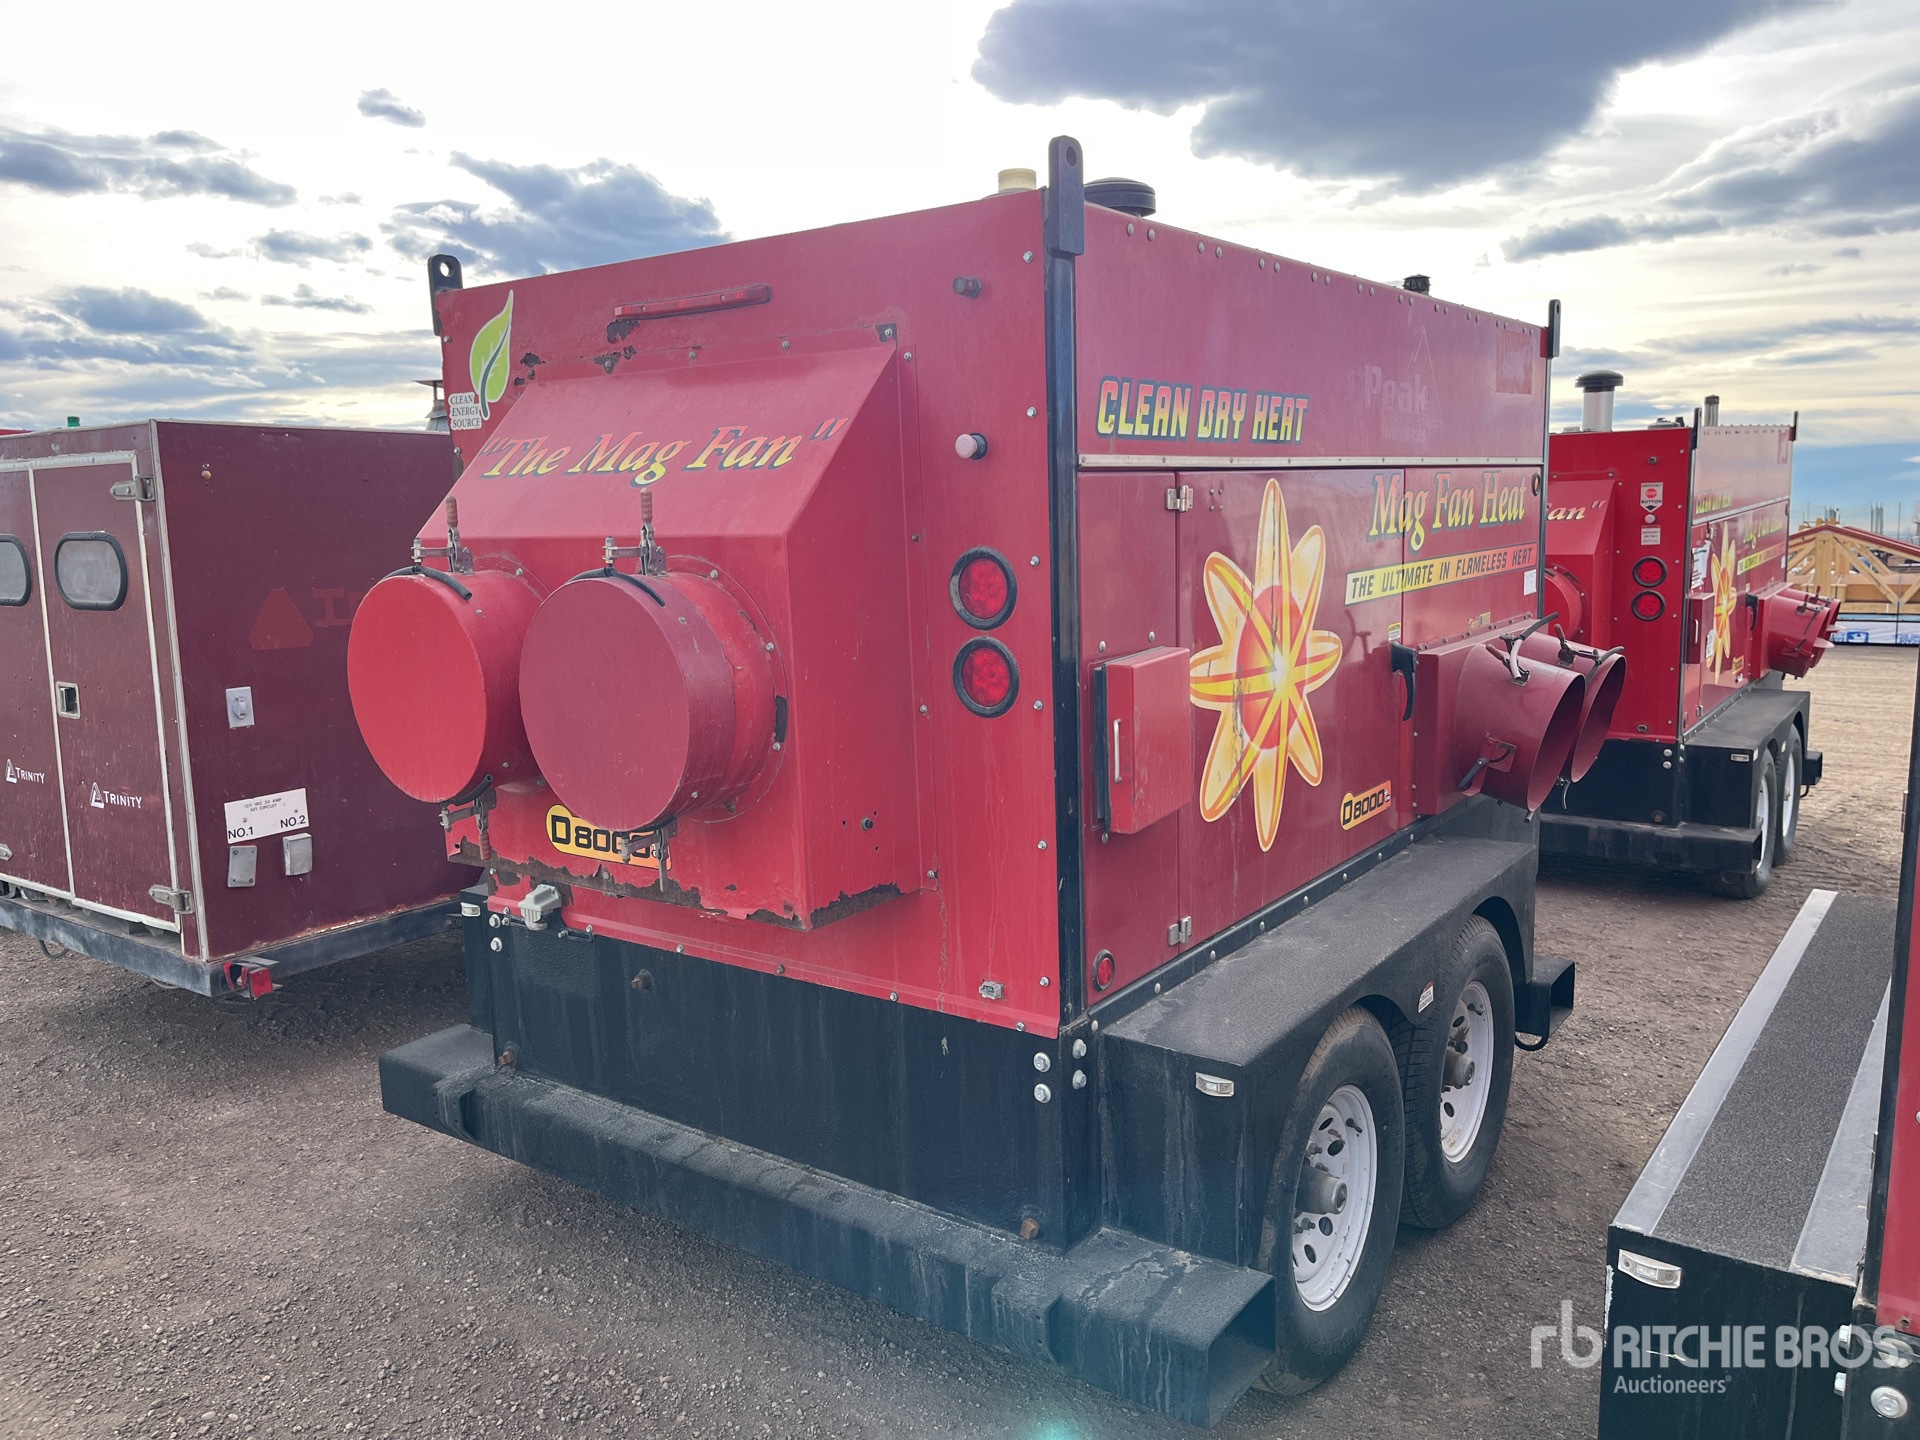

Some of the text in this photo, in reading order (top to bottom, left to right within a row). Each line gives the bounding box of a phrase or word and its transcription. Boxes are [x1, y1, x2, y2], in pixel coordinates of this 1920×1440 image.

[450, 395, 474, 405] CLEAN
[452, 406, 480, 416] ENERGY
[1096, 378, 1311, 443] CLEAN DRY HEAT
[453, 418, 481, 428] SOURCE
[562, 430, 694, 487] Mag
[1366, 470, 1528, 555] Mag Fan Heat
[1352, 547, 1533, 599] THE ULTIMATE IN FLAMELESS HEAT
[15, 767, 45, 784] TRINITY
[103, 790, 142, 809] TRINITY
[259, 803, 278, 811] CIRCUIT
[280, 815, 306, 829] NO.2
[228, 826, 254, 840] NO.1
